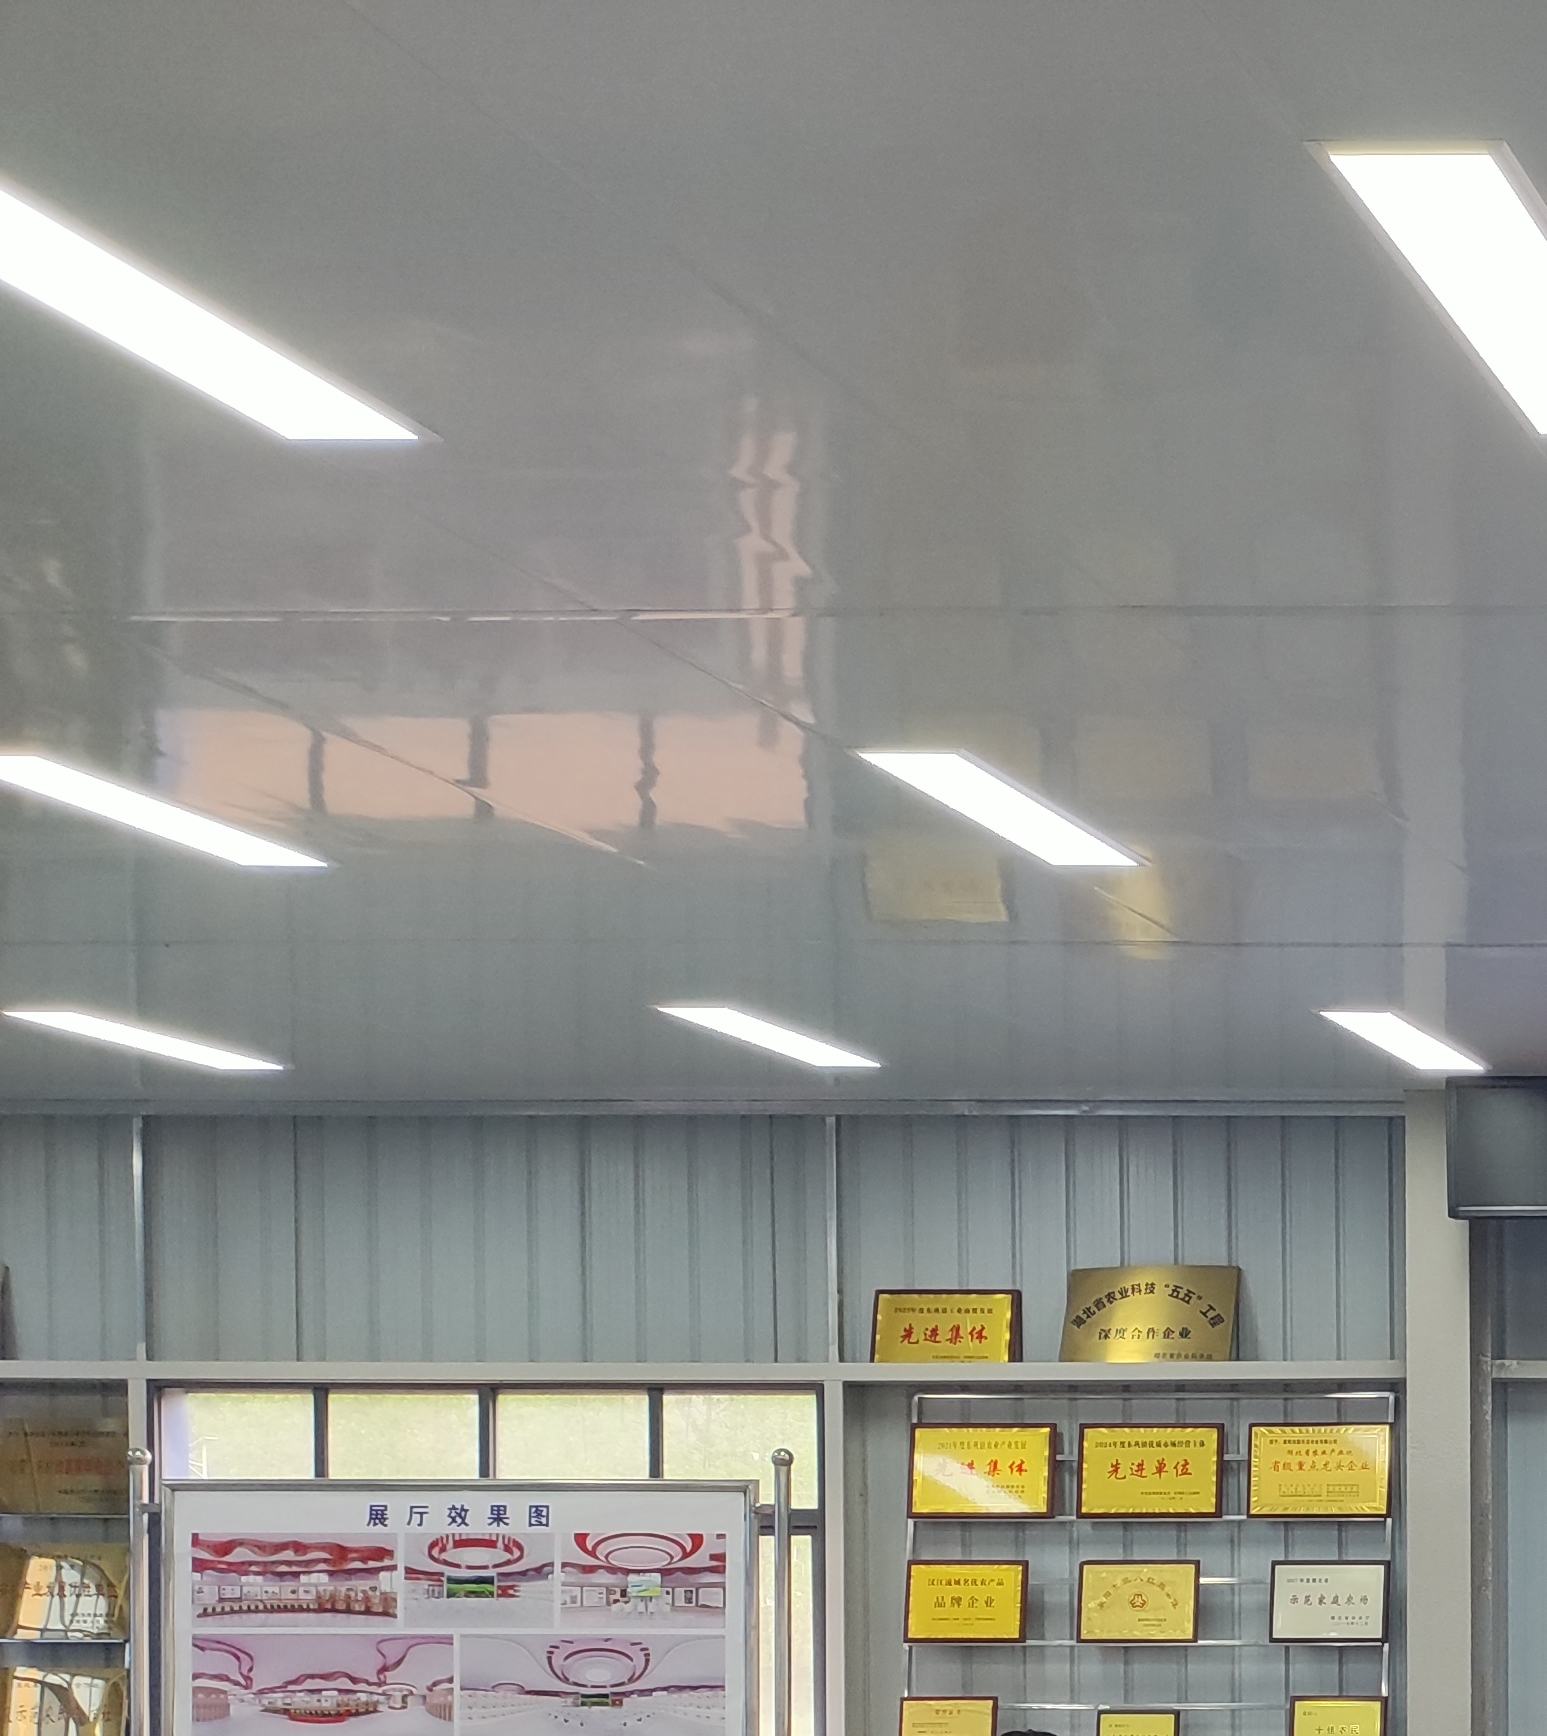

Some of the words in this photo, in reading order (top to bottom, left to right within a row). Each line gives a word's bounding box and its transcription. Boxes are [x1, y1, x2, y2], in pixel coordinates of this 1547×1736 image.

[899, 1322, 989, 1346] 先进集体
[1097, 1326, 1192, 1340] 深度合作企业
[934, 1458, 1028, 1478] 先进集体
[1106, 1458, 1193, 1480] 先进单位
[366, 1504, 550, 1528] 展厅效果图
[933, 1595, 995, 1609] 品牌企业
